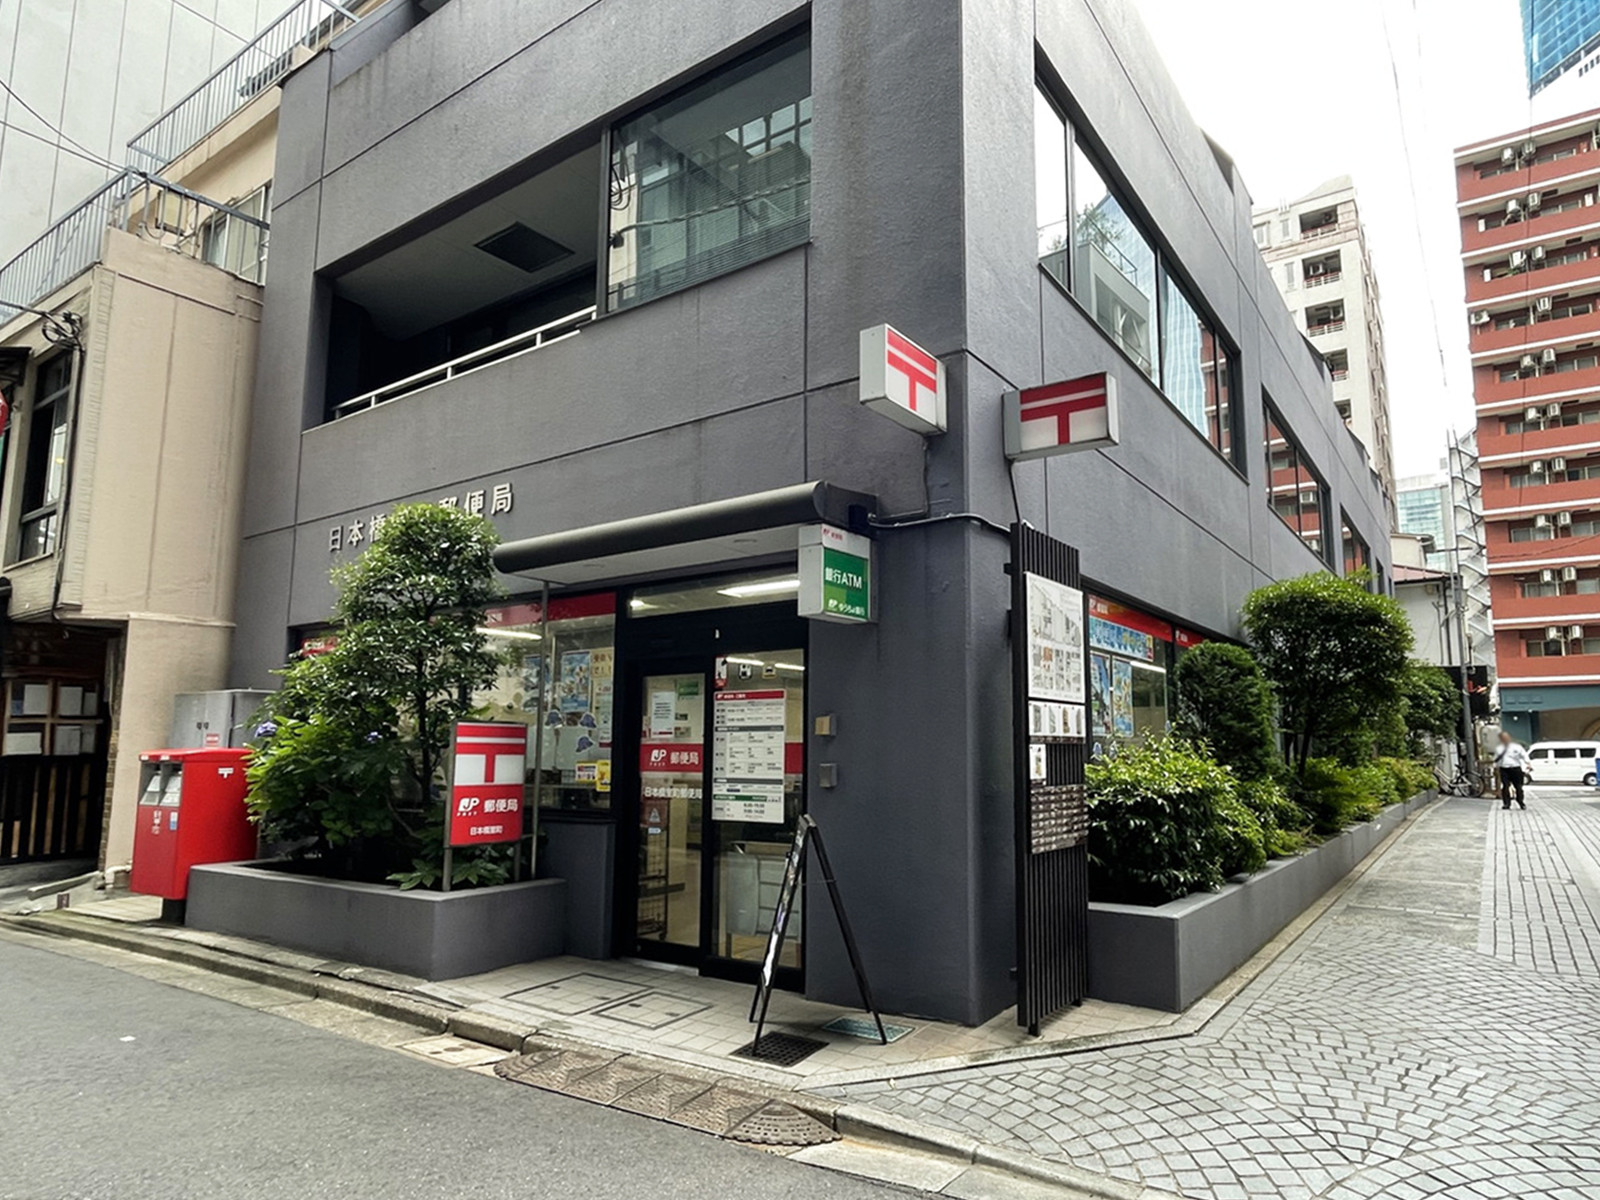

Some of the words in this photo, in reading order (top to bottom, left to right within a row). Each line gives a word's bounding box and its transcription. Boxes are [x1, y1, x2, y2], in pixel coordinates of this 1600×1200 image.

[670, 751, 699, 766] 郵便局
[484, 798, 518, 812] 郵便局
